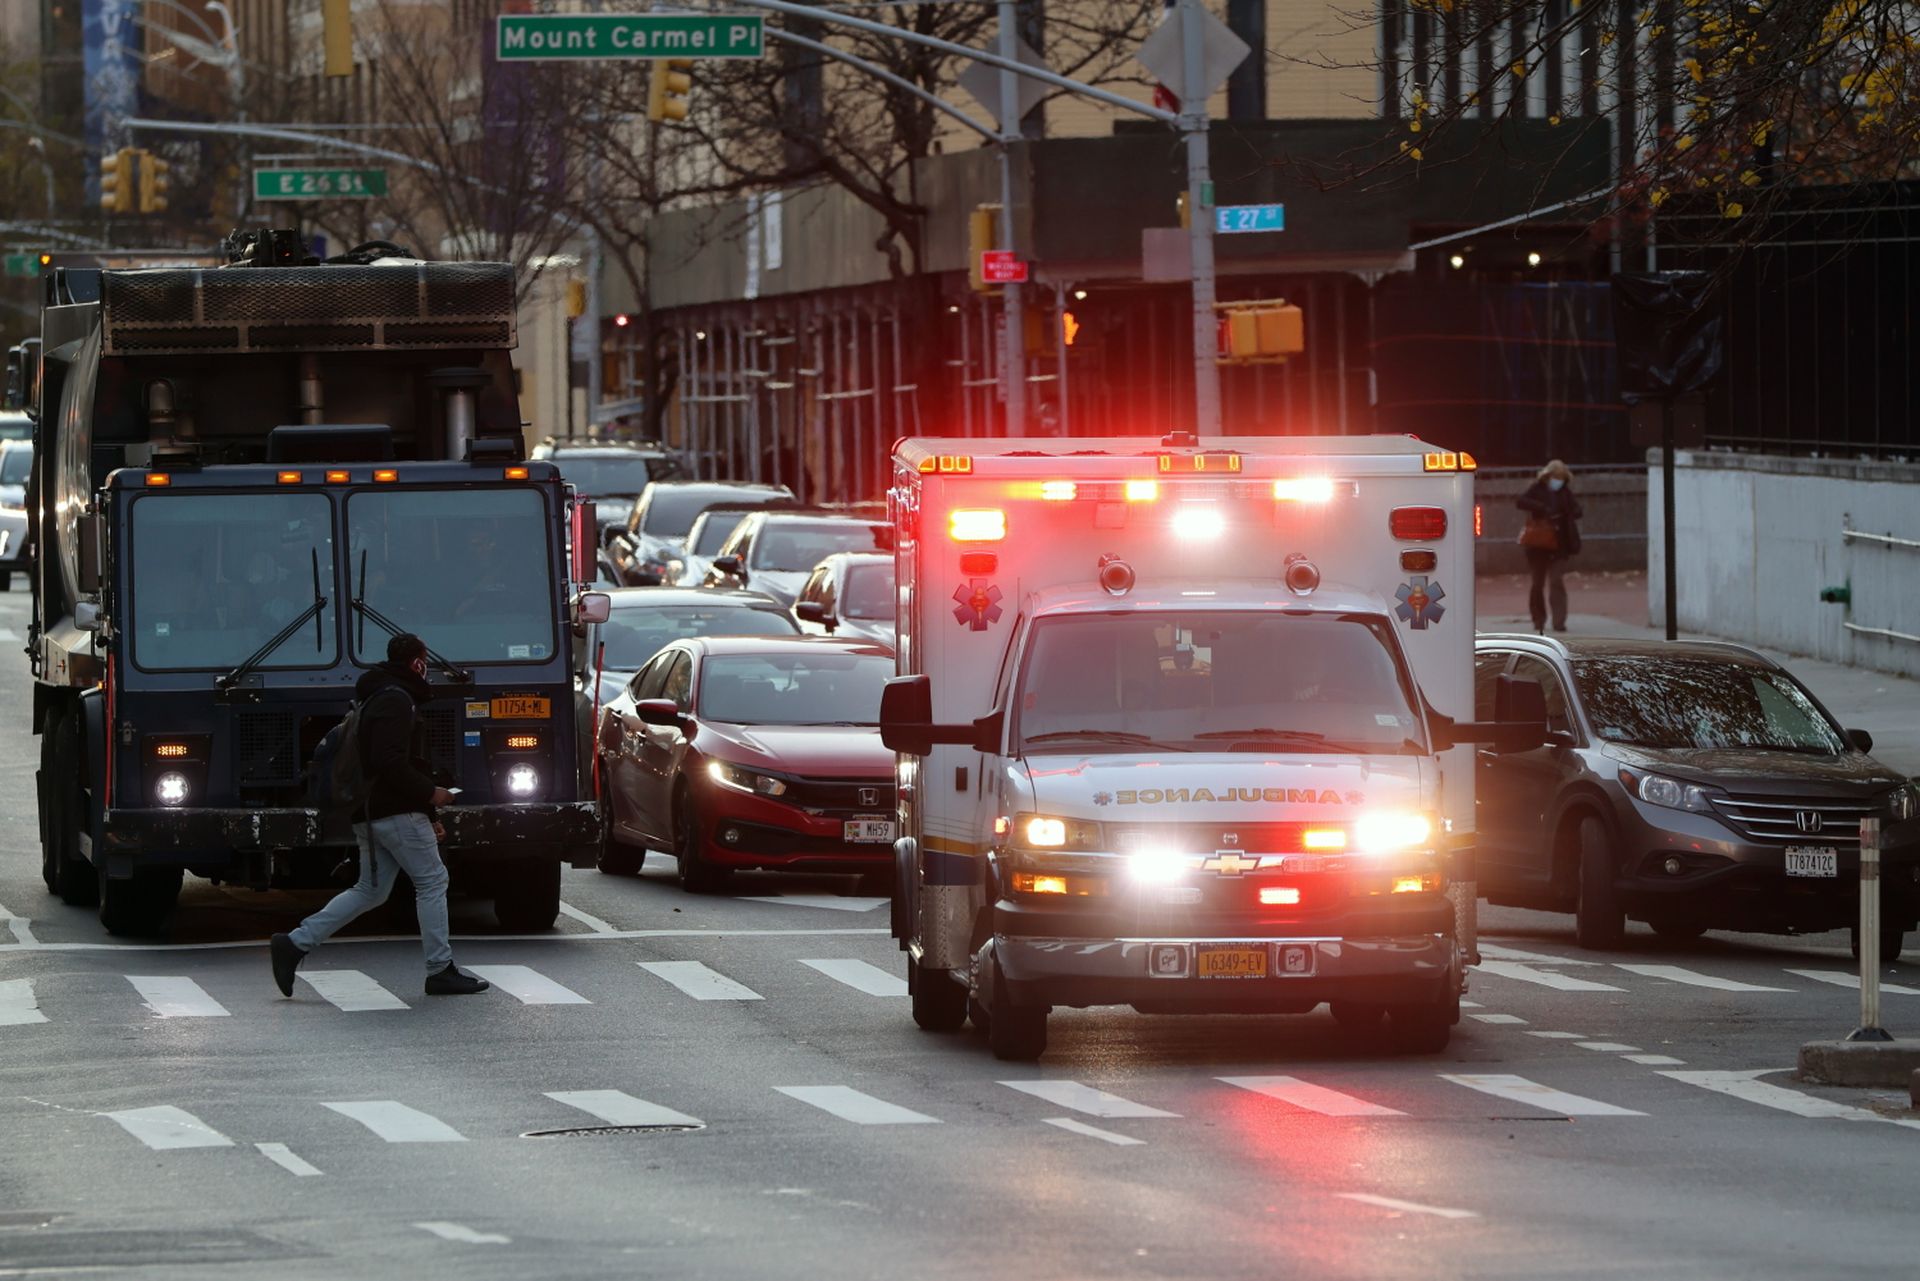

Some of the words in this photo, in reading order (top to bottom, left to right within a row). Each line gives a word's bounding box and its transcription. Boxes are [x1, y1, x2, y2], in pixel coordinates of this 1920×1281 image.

[505, 26, 597, 48] Mount
[611, 26, 716, 48] Carmel
[729, 25, 757, 47] Pl
[280, 174, 294, 193] E
[301, 174, 331, 193] 26
[1220, 210, 1231, 230] E
[1238, 210, 1260, 229] 27
[1788, 854, 1834, 871] T787412C
